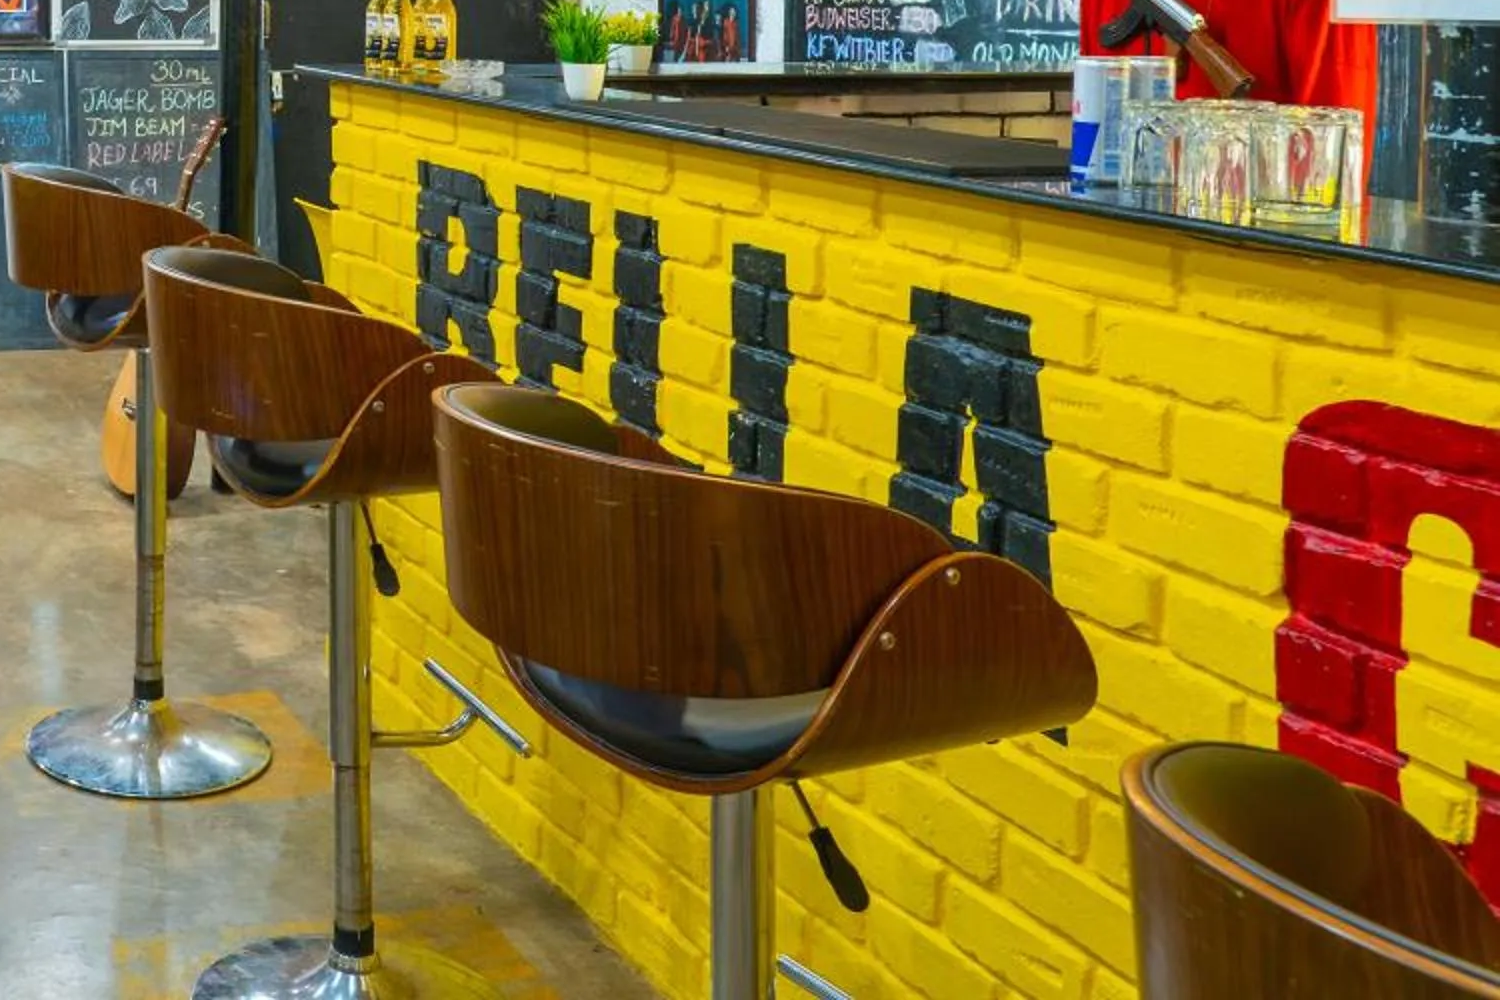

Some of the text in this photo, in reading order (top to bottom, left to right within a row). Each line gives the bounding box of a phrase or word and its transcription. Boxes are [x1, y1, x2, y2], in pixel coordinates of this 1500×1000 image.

[83, 87, 216, 113] JAGER BOMB
[85, 116, 185, 137] JIM BEAM
[87, 138, 187, 169] RED LABEL
